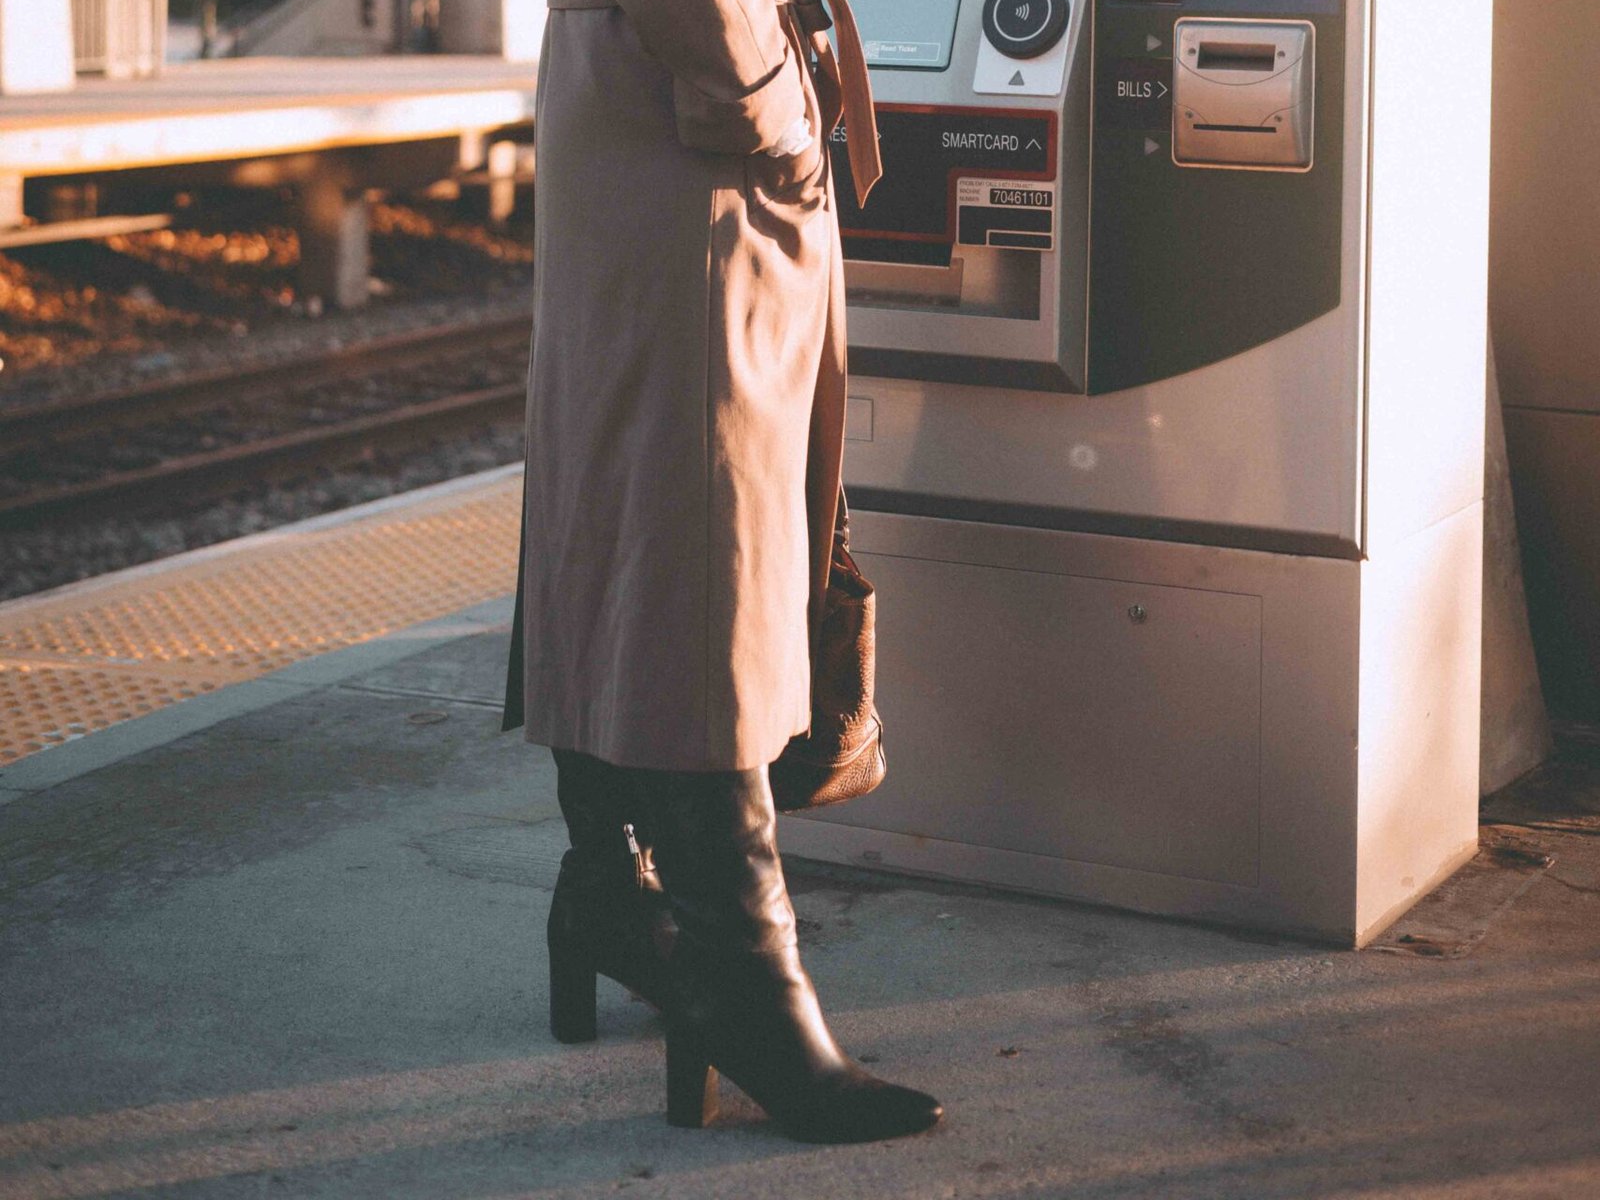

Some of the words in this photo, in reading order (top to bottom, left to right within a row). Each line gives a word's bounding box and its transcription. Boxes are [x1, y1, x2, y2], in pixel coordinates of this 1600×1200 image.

[1117, 81, 1152, 98] BILLS
[942, 132, 1019, 151] SMARTCARD
[993, 190, 1049, 205] 70461101
